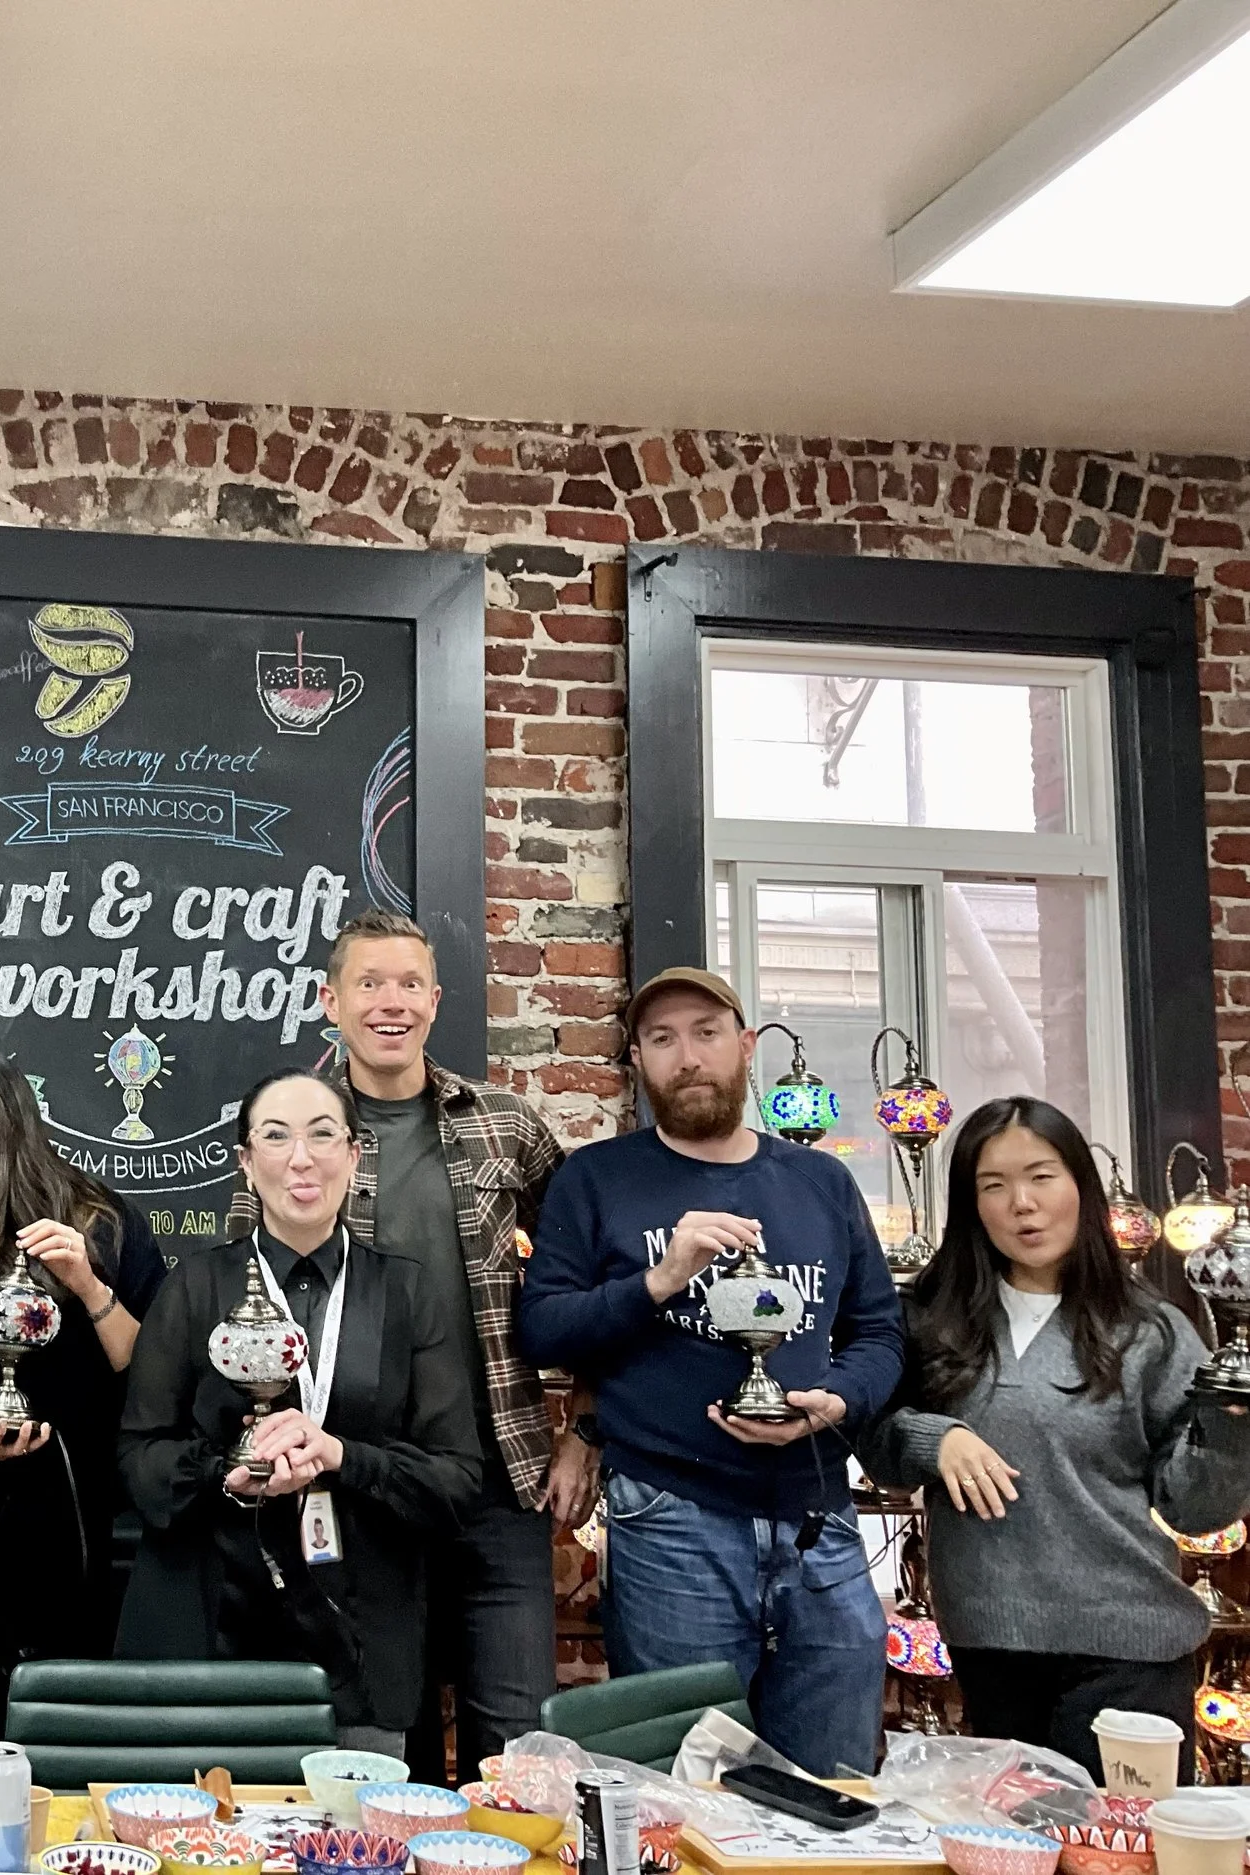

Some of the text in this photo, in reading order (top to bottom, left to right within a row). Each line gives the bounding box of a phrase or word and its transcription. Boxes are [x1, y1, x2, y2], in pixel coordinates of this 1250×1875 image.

[175, 745, 262, 772] street
[57, 796, 224, 823] SAN FRANCISCO
[88, 860, 152, 939] &
[171, 864, 349, 964] craft
[113, 1141, 228, 1179] BUILDING
[149, 1210, 216, 1235] 10 AM
[654, 1309, 724, 1341] ARIS.
